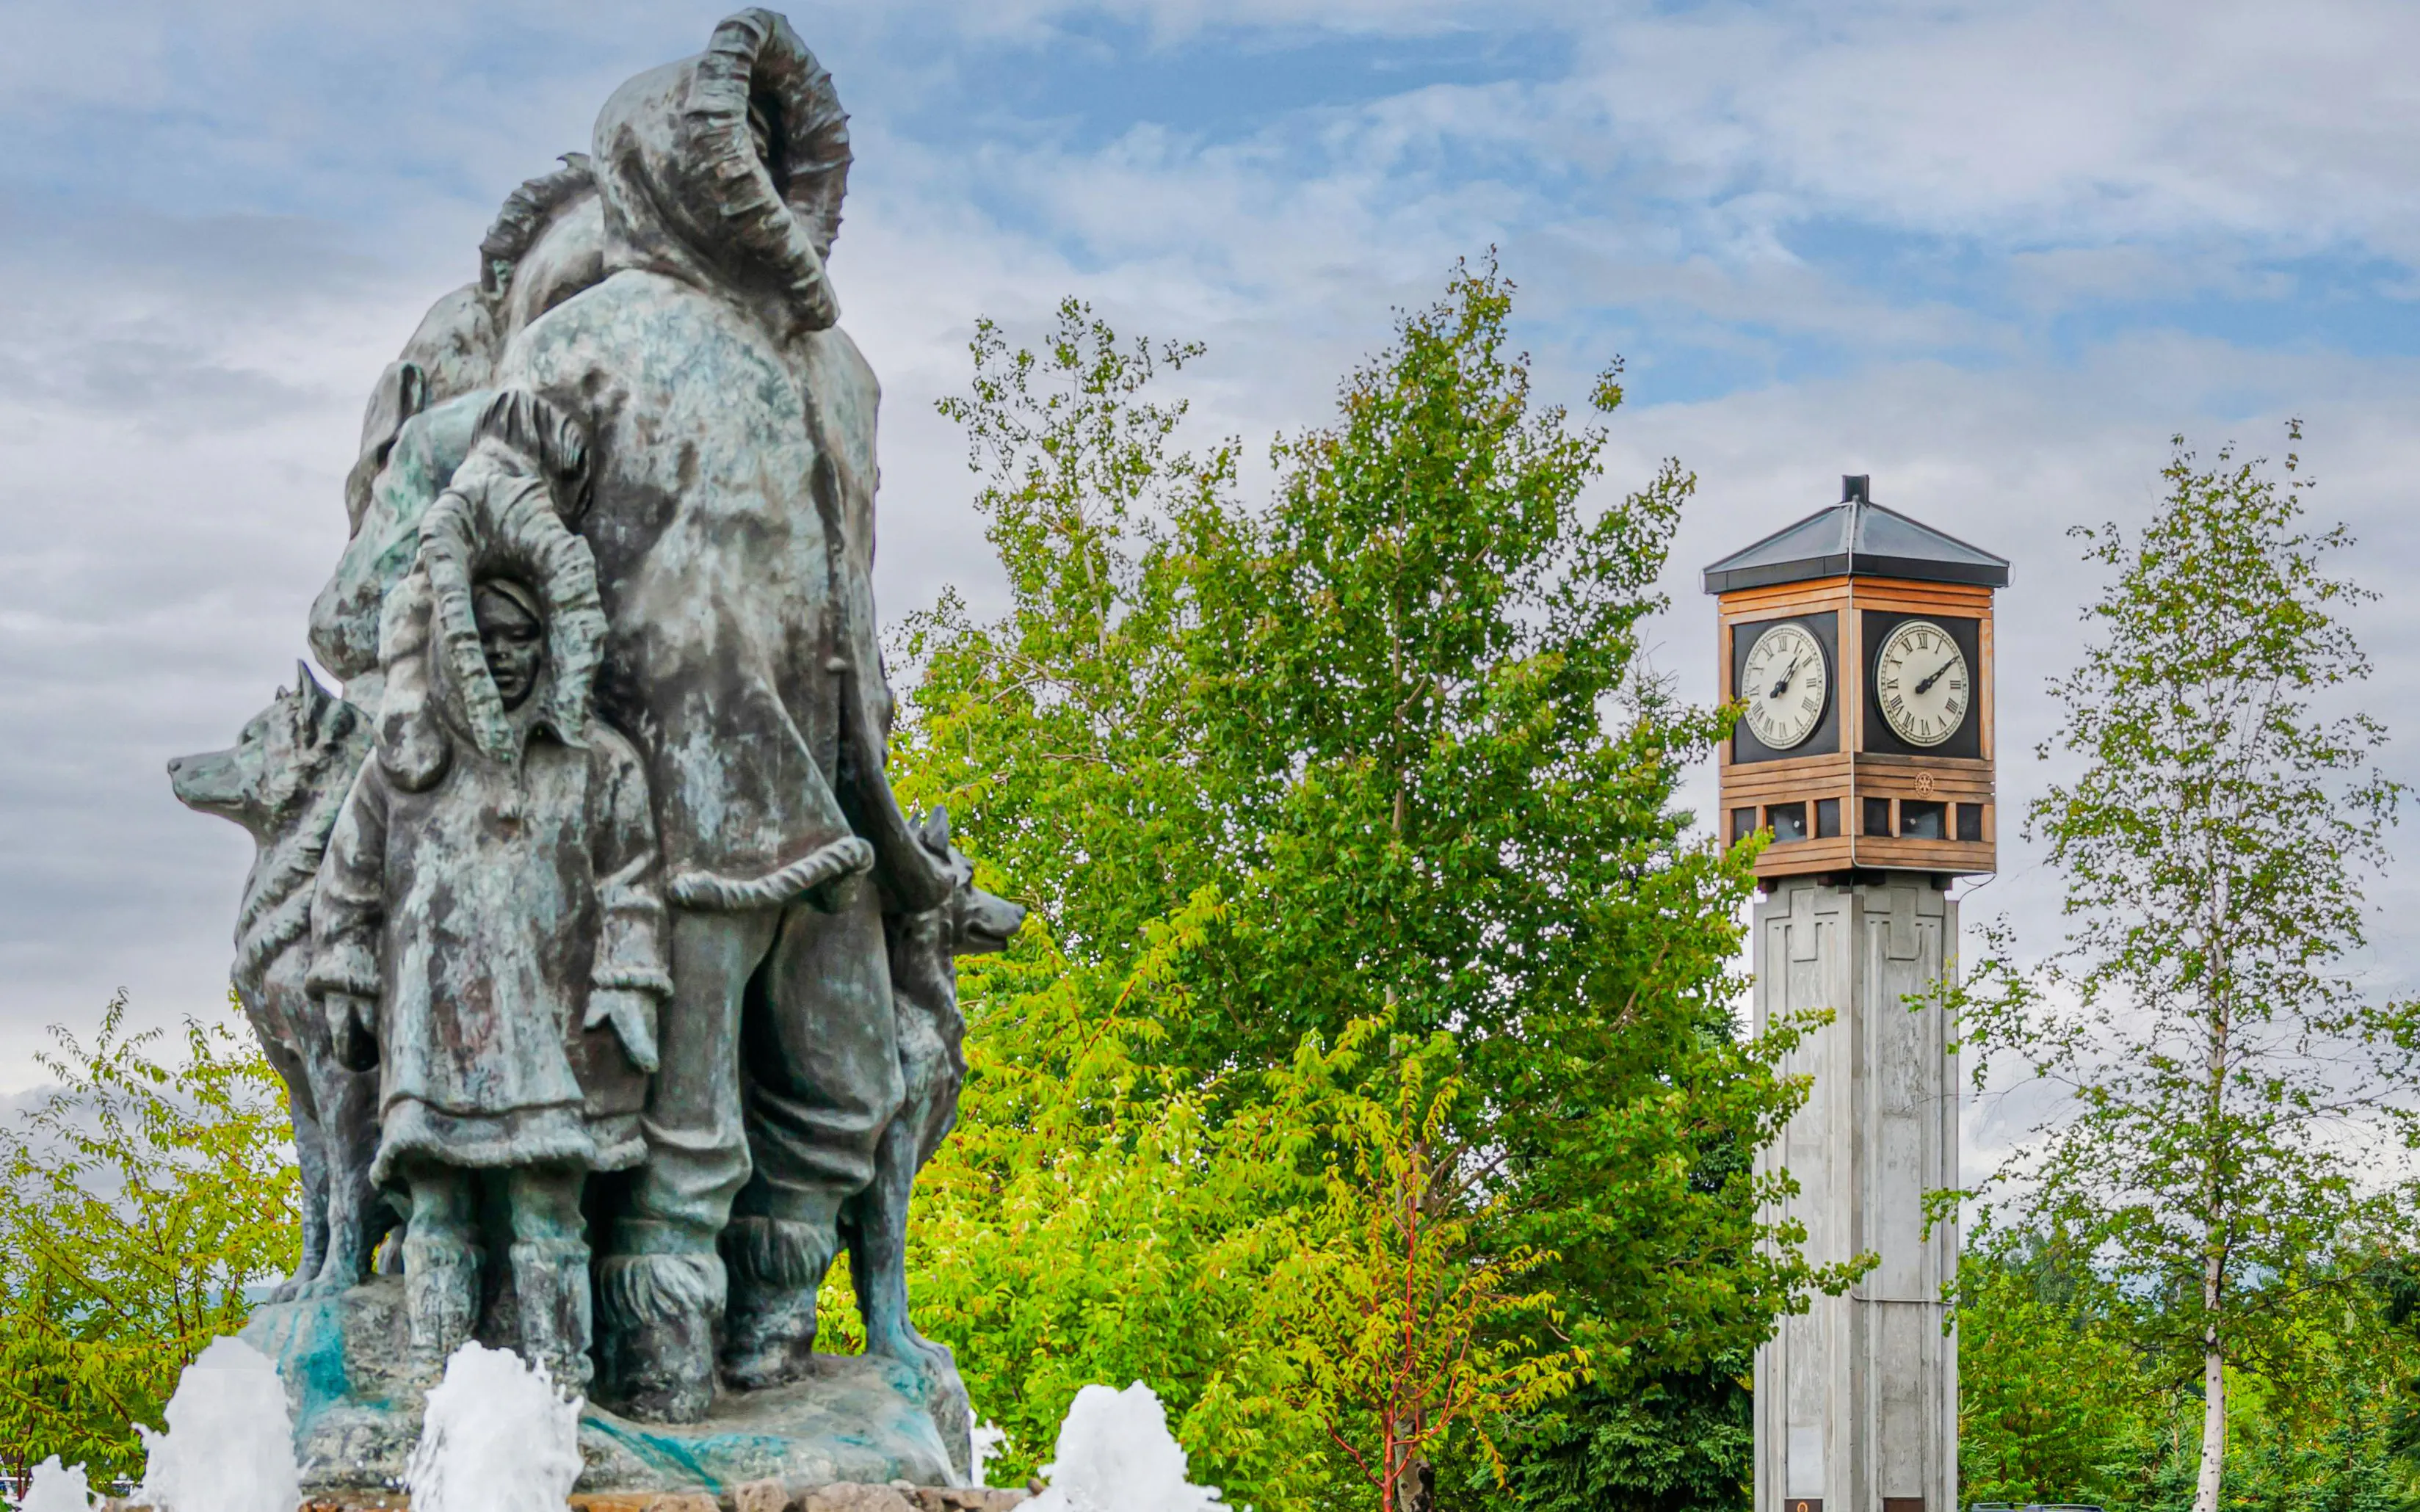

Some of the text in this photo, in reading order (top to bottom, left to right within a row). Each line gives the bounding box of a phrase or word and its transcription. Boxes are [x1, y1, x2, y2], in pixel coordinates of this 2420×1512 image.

[1778, 636, 1787, 653] XII
[1901, 637, 1913, 655] XI
[1917, 633, 1928, 650] XII
[1806, 677, 1816, 688] III
[1886, 677, 1899, 690] IX
[1949, 680, 1961, 690] III
[1890, 694, 1905, 716] VIII
[1946, 697, 1959, 715] IIII
[1794, 715, 1803, 732] V
[1902, 711, 1916, 732] VII
[1920, 719, 1930, 735] VI
[1938, 714, 1946, 732] V
